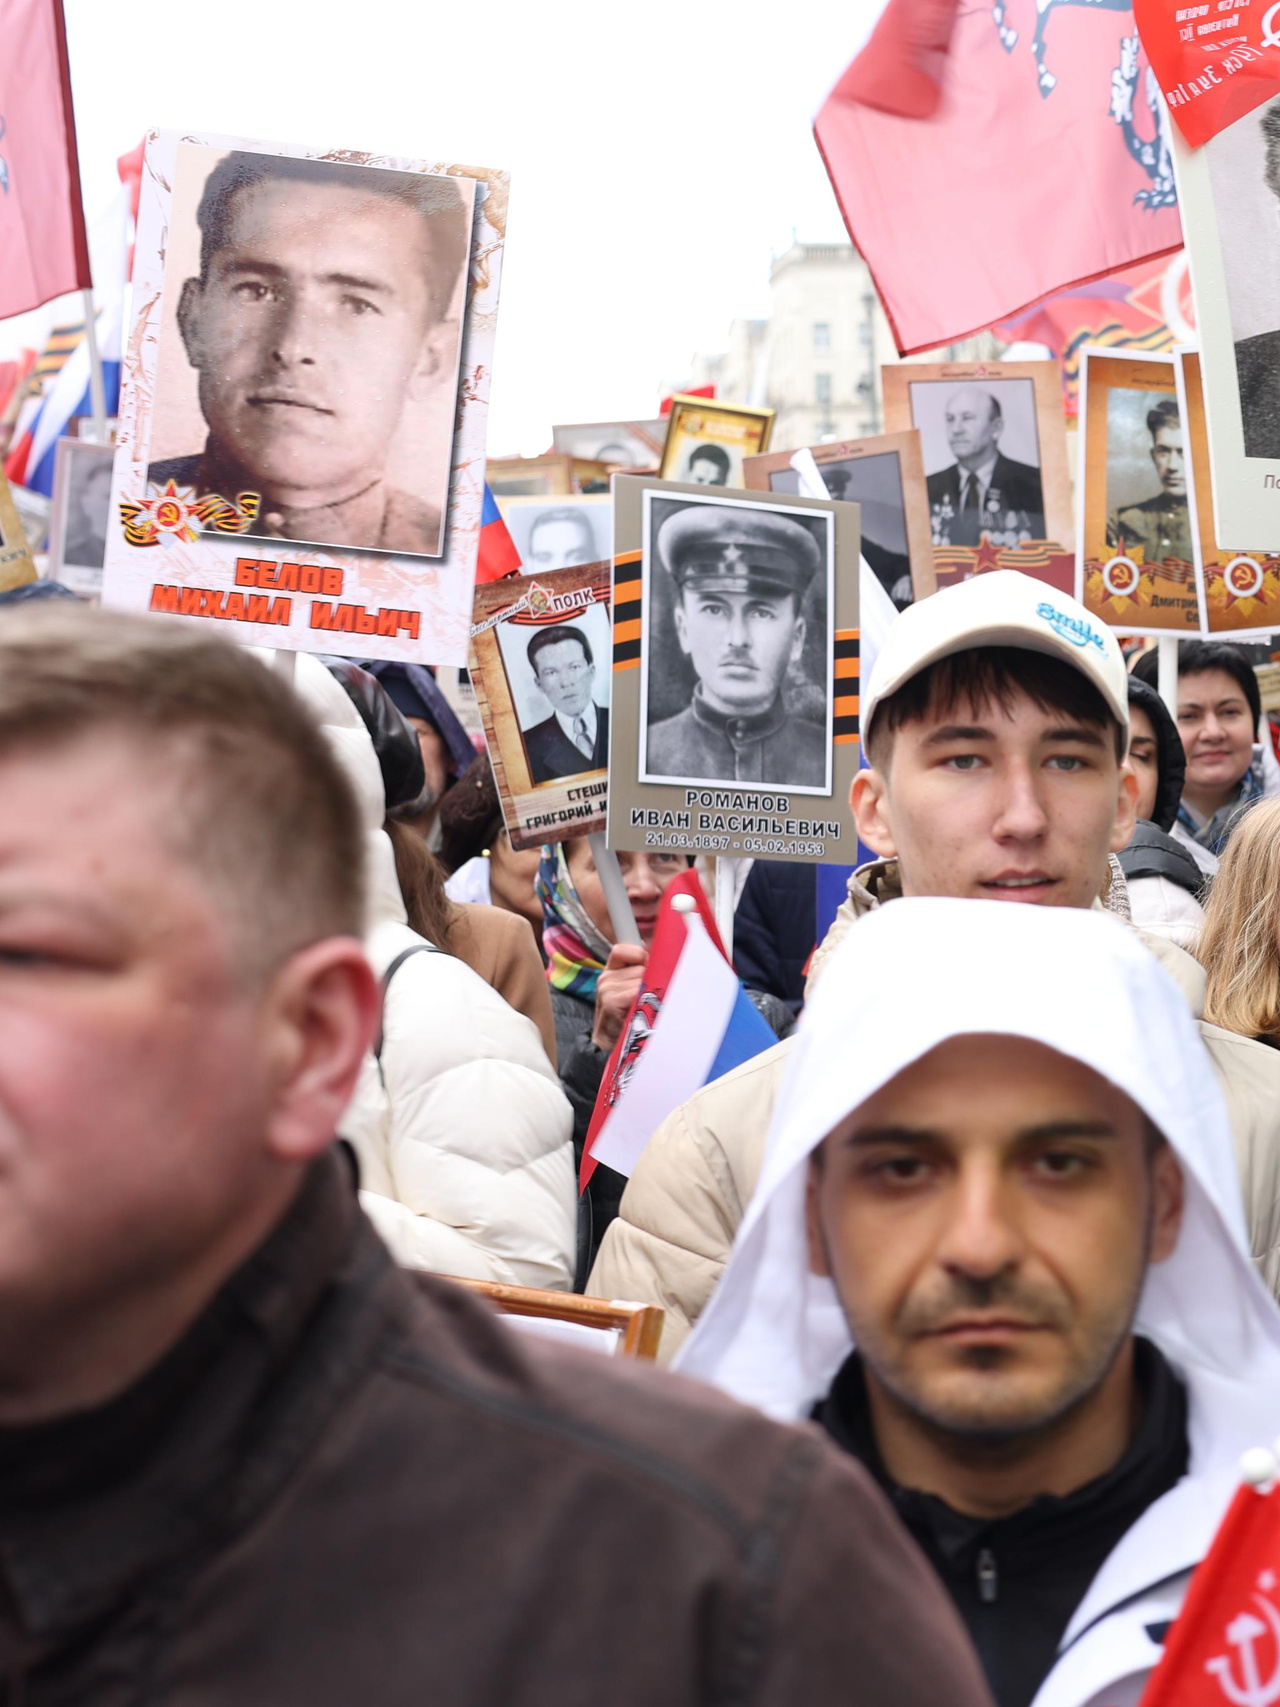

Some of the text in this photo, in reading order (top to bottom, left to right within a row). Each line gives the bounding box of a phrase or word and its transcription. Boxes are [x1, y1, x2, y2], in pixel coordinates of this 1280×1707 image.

[235, 557, 344, 597] БЕЛОВ
[149, 583, 421, 640] МИХАИЛ ИЛЬИЧ
[553, 588, 595, 612] ПОЛК
[525, 800, 594, 830] ГРИГОРИЙ
[686, 789, 790, 813] РОМАНОВ
[630, 808, 841, 840] ИВАН ВАСИЛЬЕВИЧ
[645, 831, 730, 850] 21.03.1897
[744, 838, 825, 856] 05.02.1953
